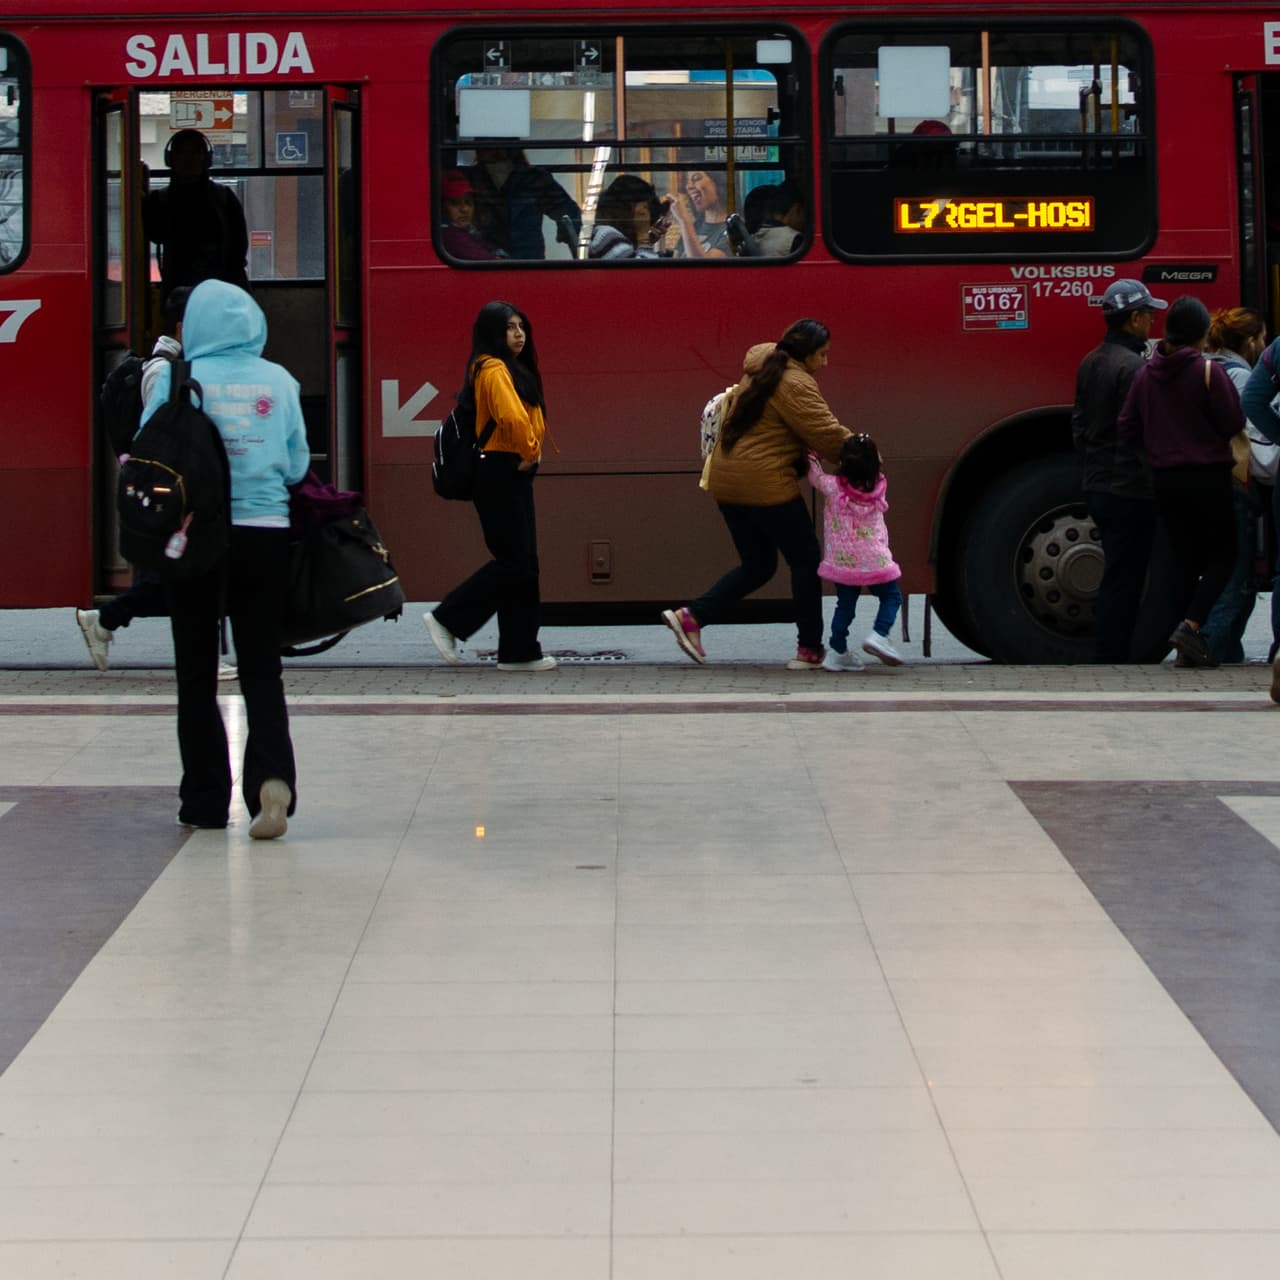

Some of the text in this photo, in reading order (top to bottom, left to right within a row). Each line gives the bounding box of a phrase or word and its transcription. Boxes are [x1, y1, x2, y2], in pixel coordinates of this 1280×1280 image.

[125, 32, 315, 78] SALIDA
[1010, 265, 1116, 279] VOLKSBUS
[1161, 271, 1213, 280] MEGA
[1032, 281, 1094, 297] 17-260
[974, 294, 1023, 311] 0167
